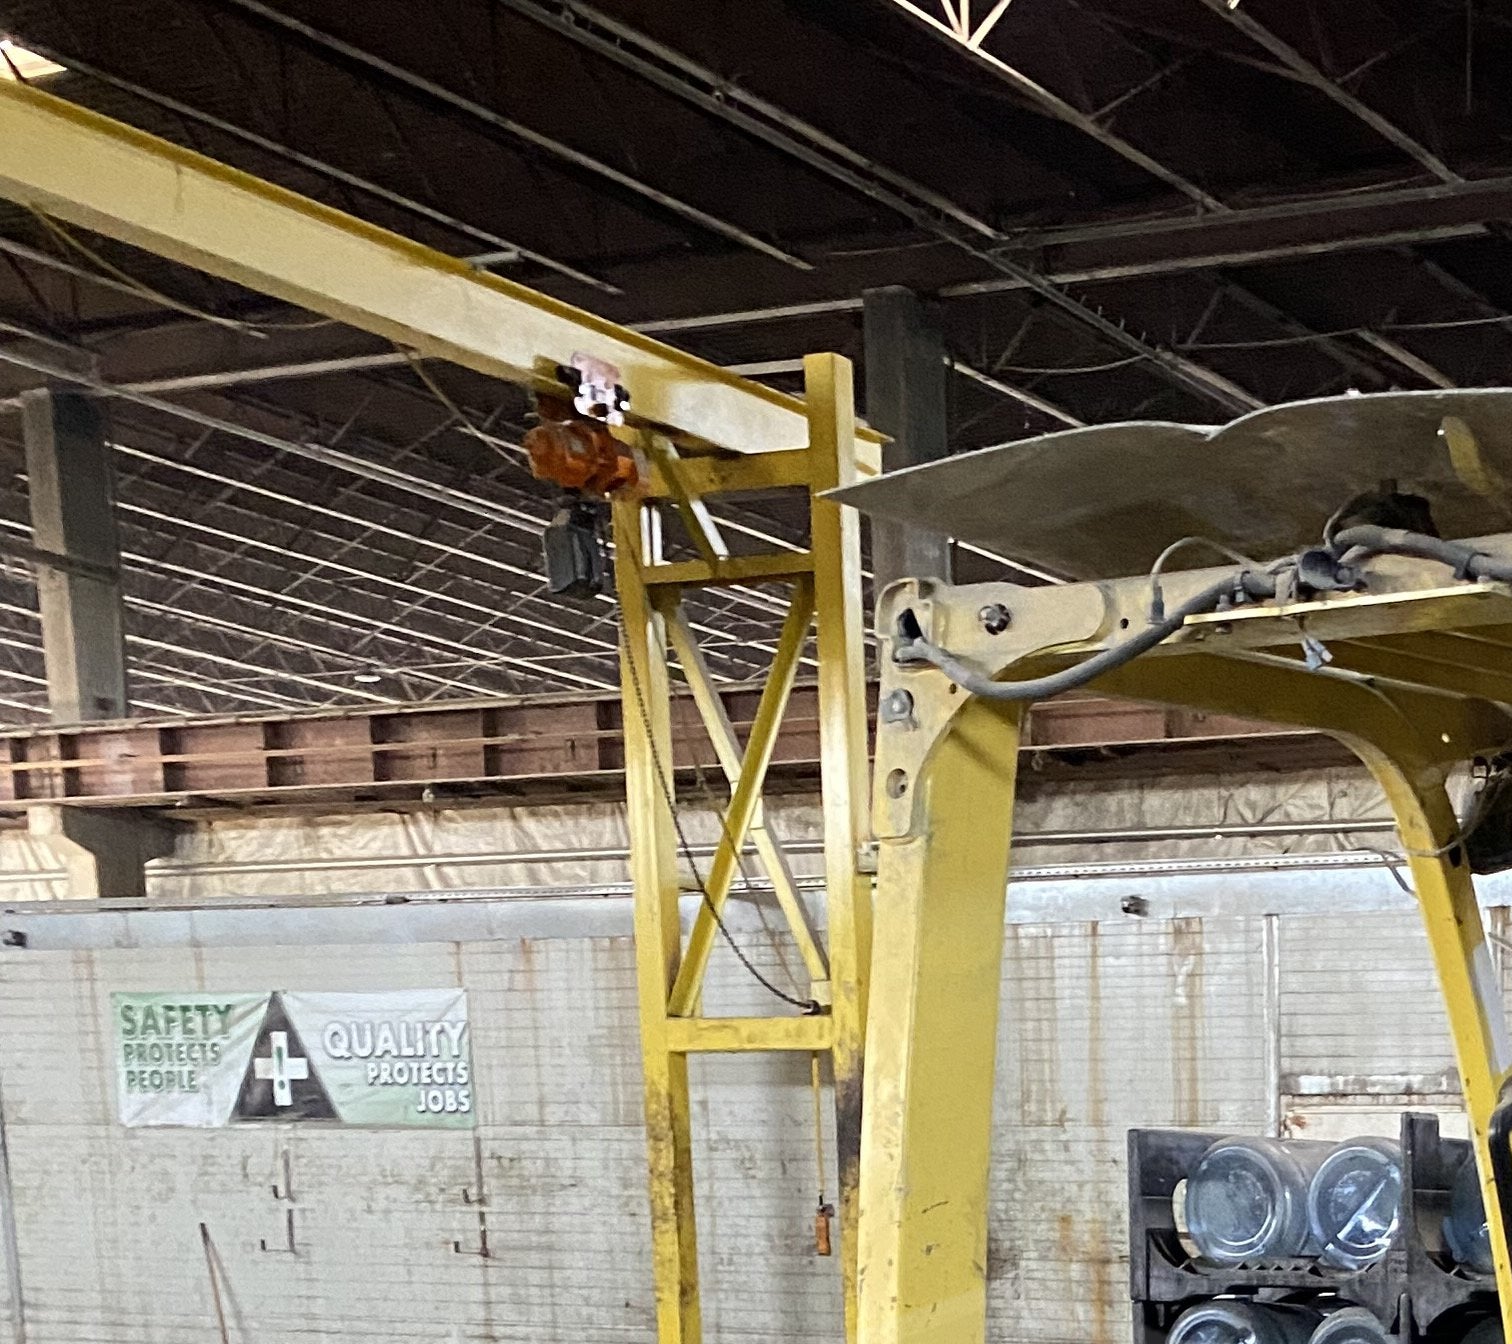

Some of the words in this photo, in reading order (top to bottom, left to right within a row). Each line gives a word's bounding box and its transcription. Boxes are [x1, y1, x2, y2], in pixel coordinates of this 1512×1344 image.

[120, 1004, 234, 1036] SAFETY
[323, 1021, 467, 1059] QUALITY
[123, 1042, 221, 1064] PROTECTS
[126, 1070, 200, 1092] PEOPLE
[367, 1062, 469, 1086] PROTECTS
[416, 1089, 470, 1113] JOBS
